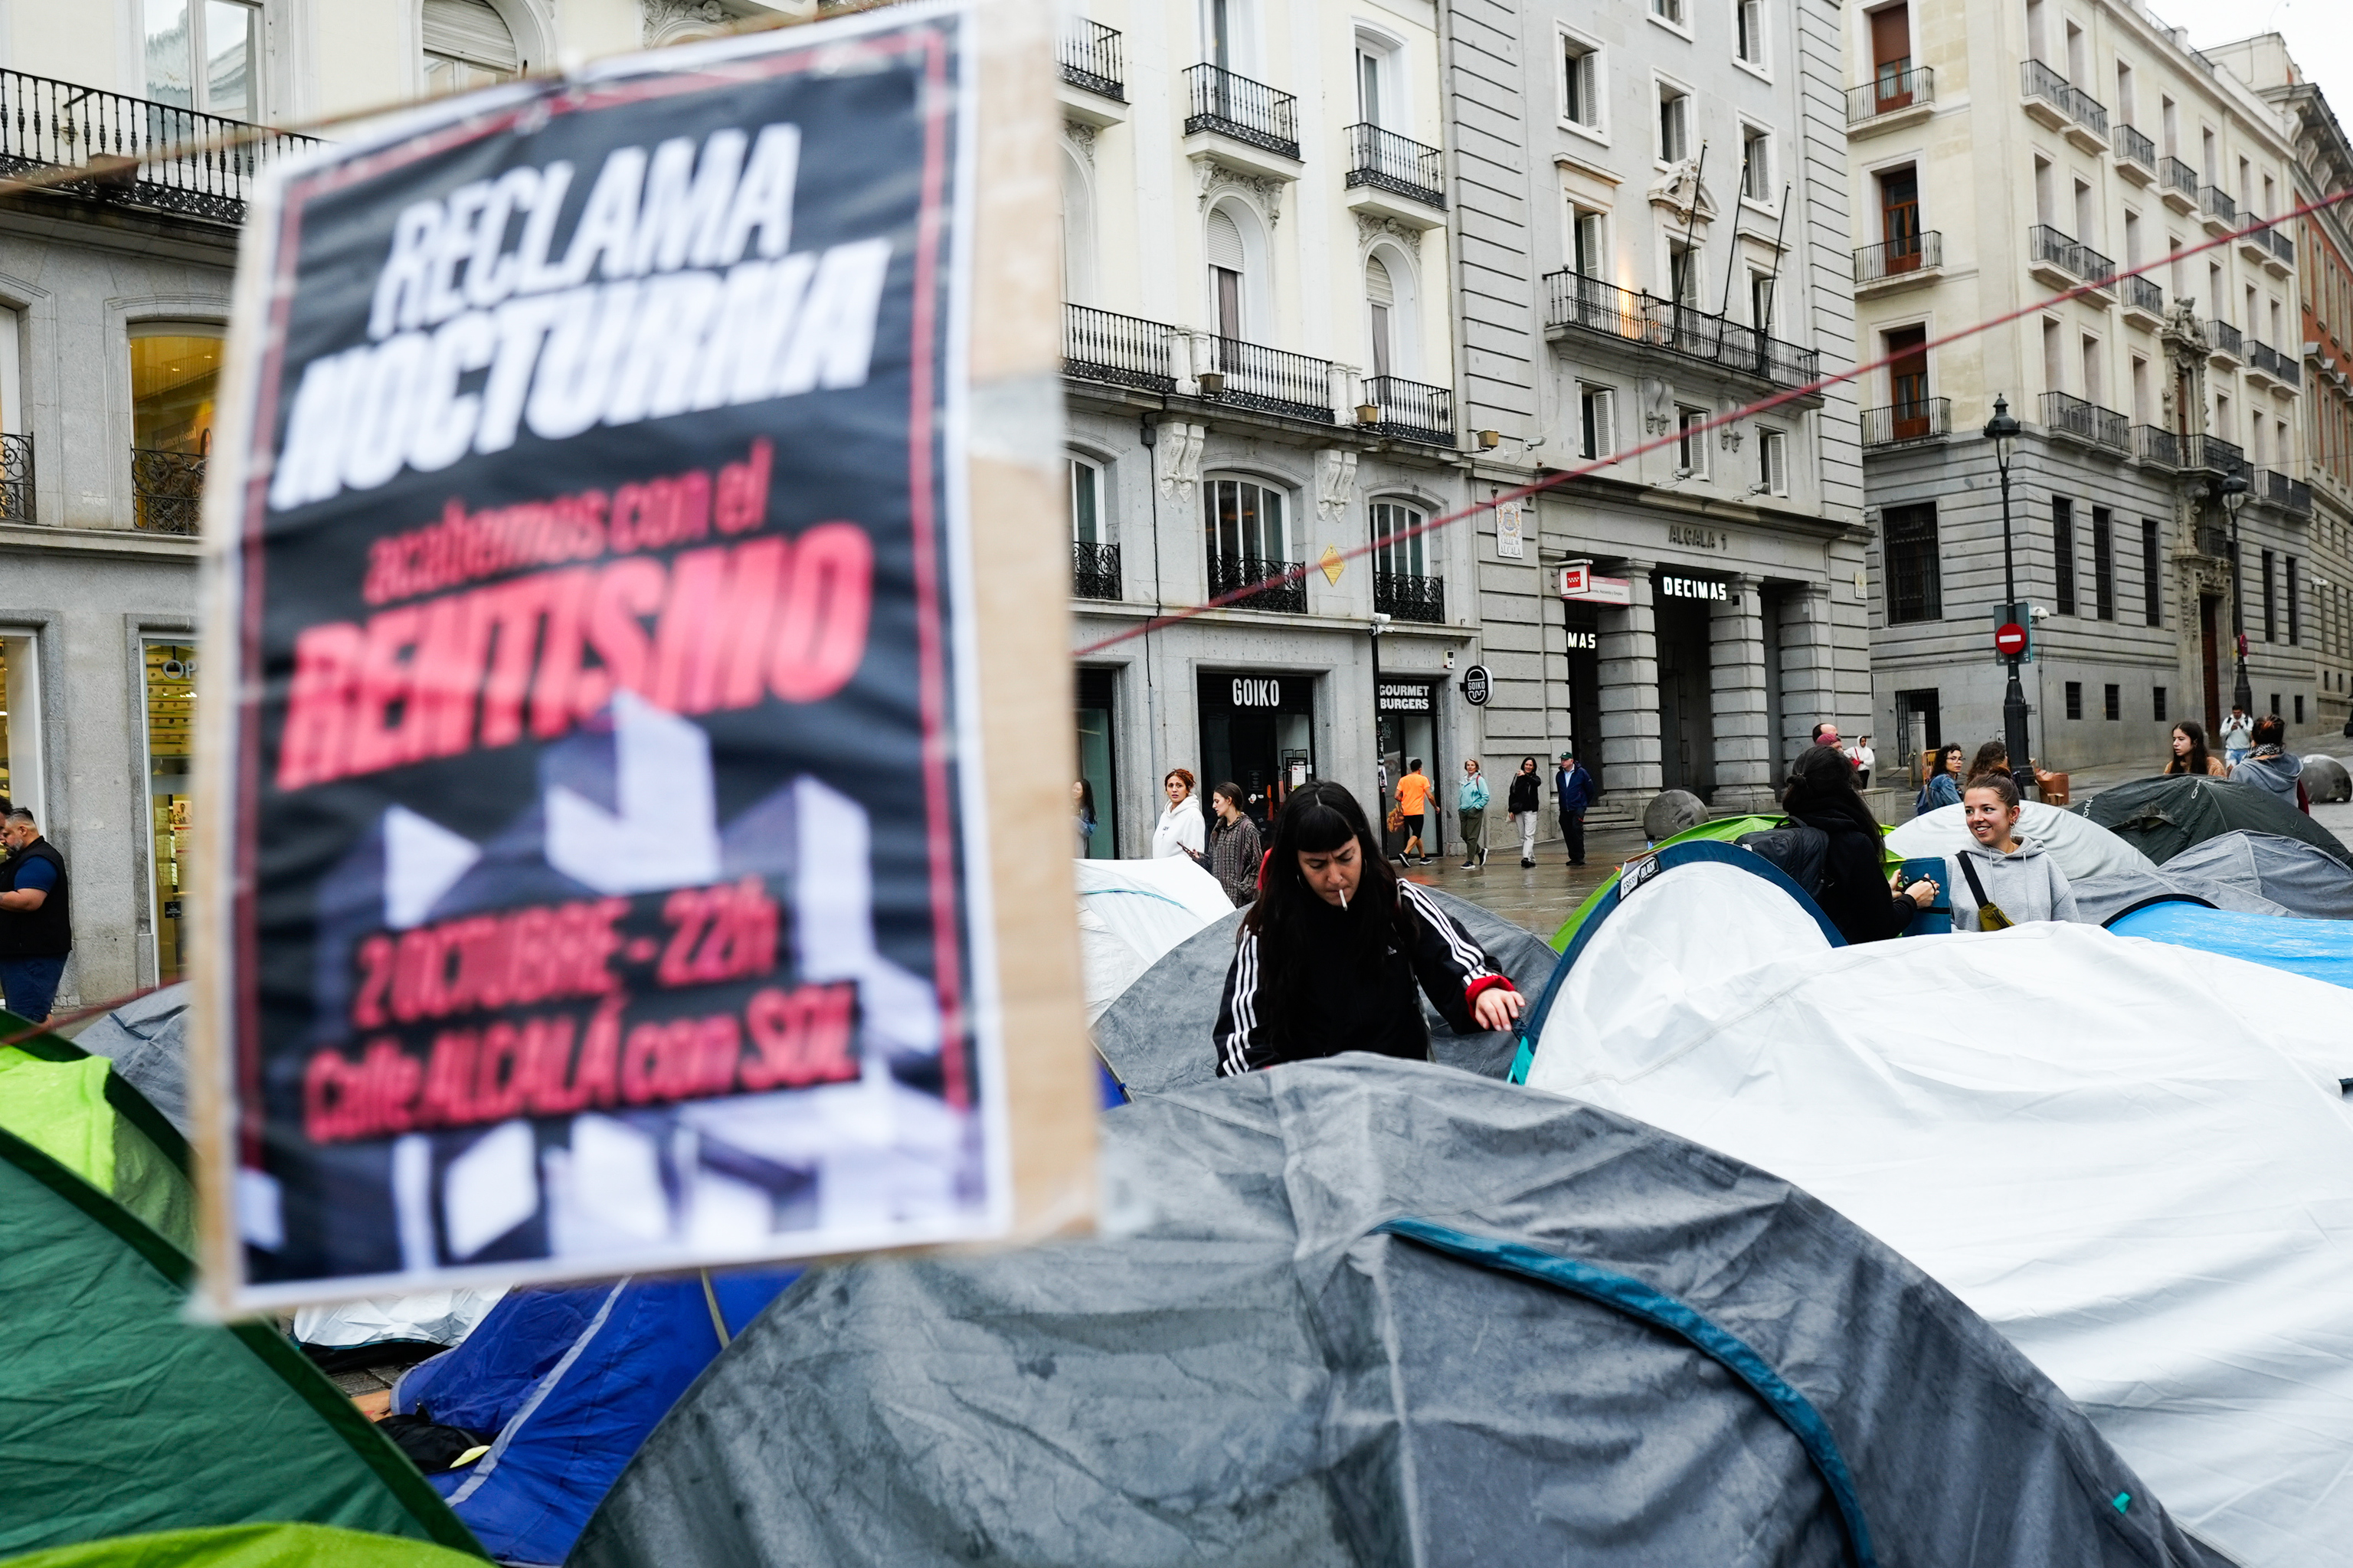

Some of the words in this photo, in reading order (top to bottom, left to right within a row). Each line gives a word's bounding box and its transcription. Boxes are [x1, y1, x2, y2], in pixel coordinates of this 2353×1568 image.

[368, 123, 801, 342] RECLAMA
[269, 236, 894, 515] NOCTURNA
[611, 467, 711, 555] con
[714, 435, 774, 535] el
[1663, 576, 1726, 601] DECIMAS
[274, 519, 875, 794] RENTISMO
[1232, 678, 1279, 706] GOIKO
[1379, 684, 1429, 697] GOURMET
[1380, 698, 1429, 710] BURGERS
[1468, 681, 1486, 691] GOIKO
[353, 934, 392, 1030] 2
[390, 898, 630, 1023] OCTUBRE
[657, 873, 782, 988] 22h
[303, 1036, 425, 1144] Calle
[423, 993, 627, 1124] ALCALÁ
[620, 1014, 742, 1105] con
[739, 981, 860, 1092] SOL
